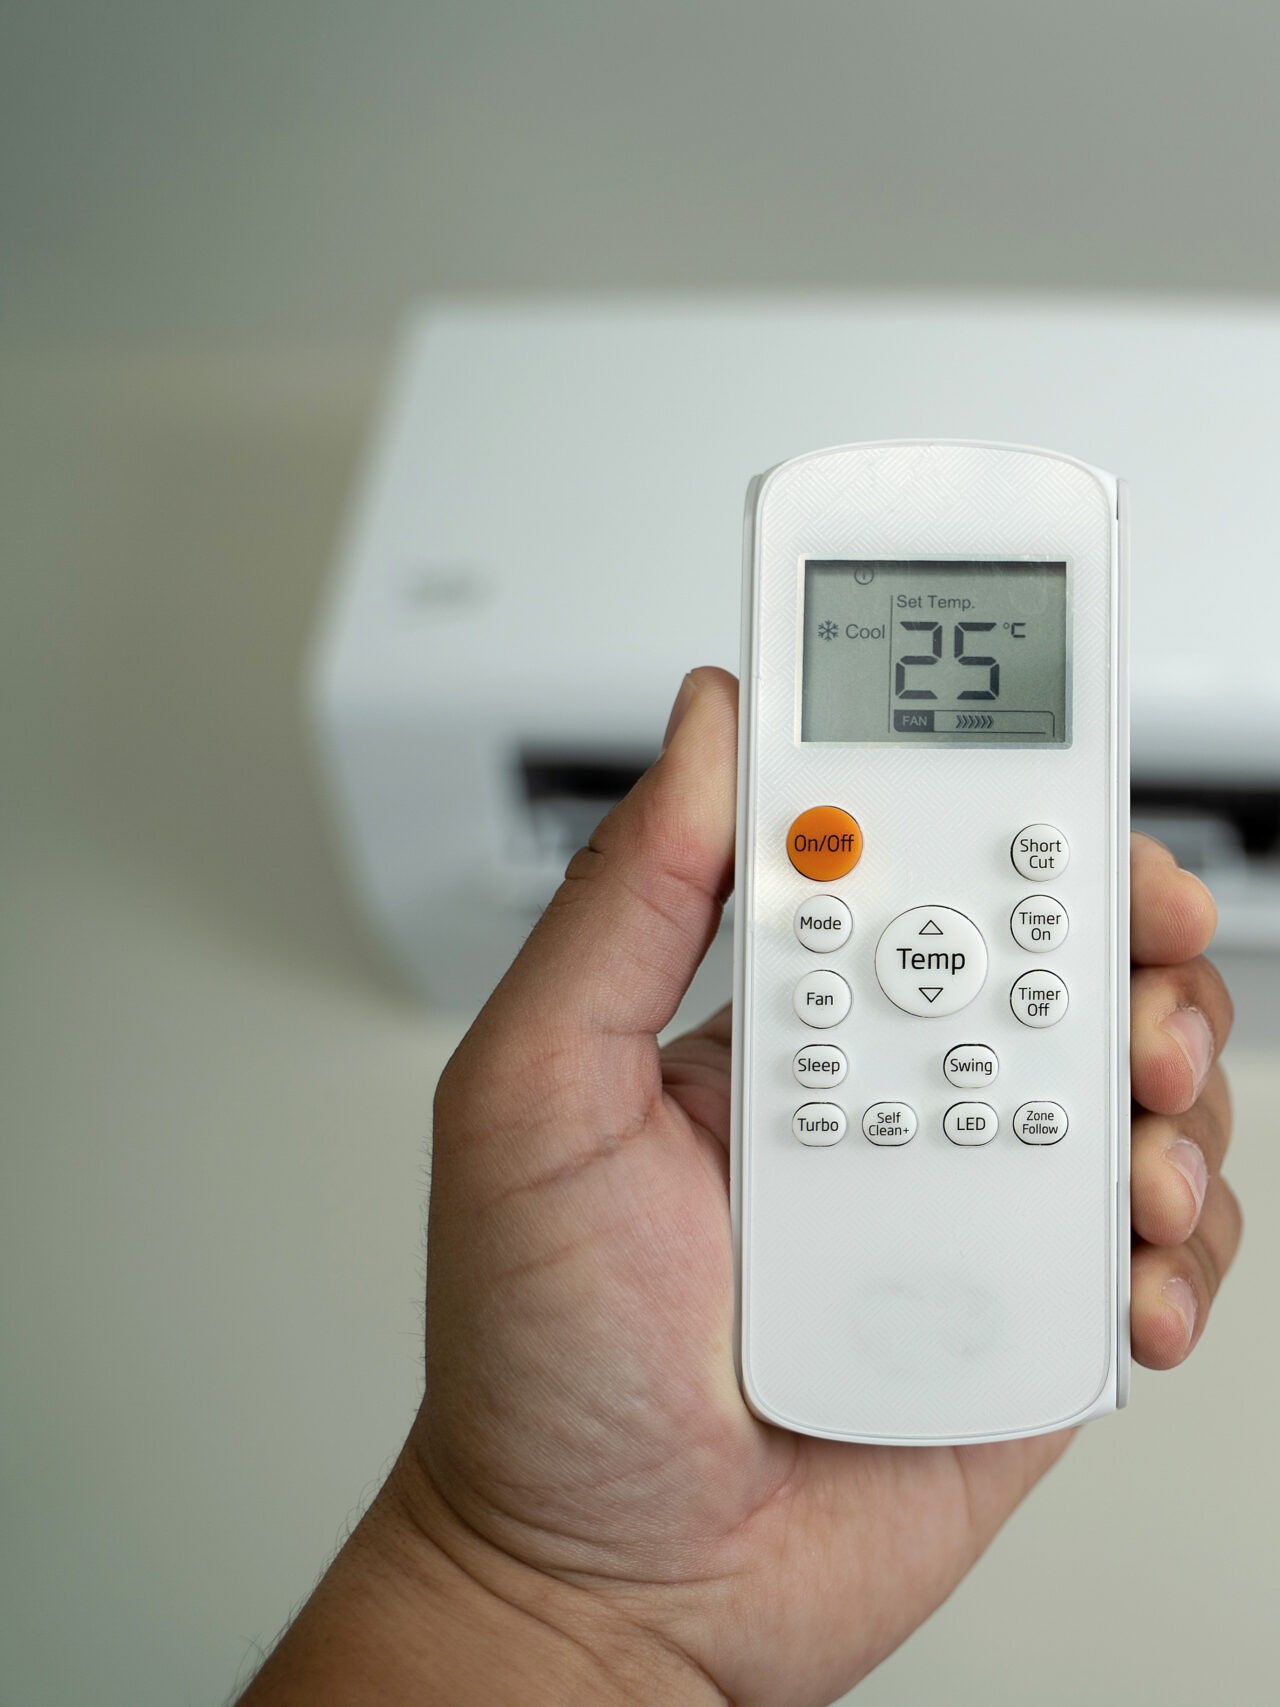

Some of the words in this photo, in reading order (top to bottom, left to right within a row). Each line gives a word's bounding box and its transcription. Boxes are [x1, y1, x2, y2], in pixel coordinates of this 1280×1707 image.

[897, 595, 922, 608] Set
[928, 596, 975, 611] Temp.
[846, 624, 885, 639] Cool
[895, 621, 1000, 700] 25
[902, 715, 927, 726] FAN
[794, 834, 854, 853] On/Off
[1020, 839, 1061, 853] Short
[1030, 856, 1055, 869] Cut
[800, 917, 842, 930] Mode
[1019, 912, 1061, 925] Timer
[1031, 928, 1051, 941] On
[897, 948, 965, 975] Temp
[807, 993, 833, 1005] Fan
[1019, 988, 1061, 1001] Timer
[1027, 1004, 1050, 1017] Off
[798, 1059, 840, 1075] Sleep
[950, 1059, 993, 1075] Swing
[877, 1112, 901, 1124] Self
[1027, 1111, 1054, 1121] Zone
[798, 1118, 839, 1132] Turbo
[868, 1124, 909, 1136] Clean+
[957, 1118, 986, 1130] LED
[1022, 1123, 1058, 1134] Follow
